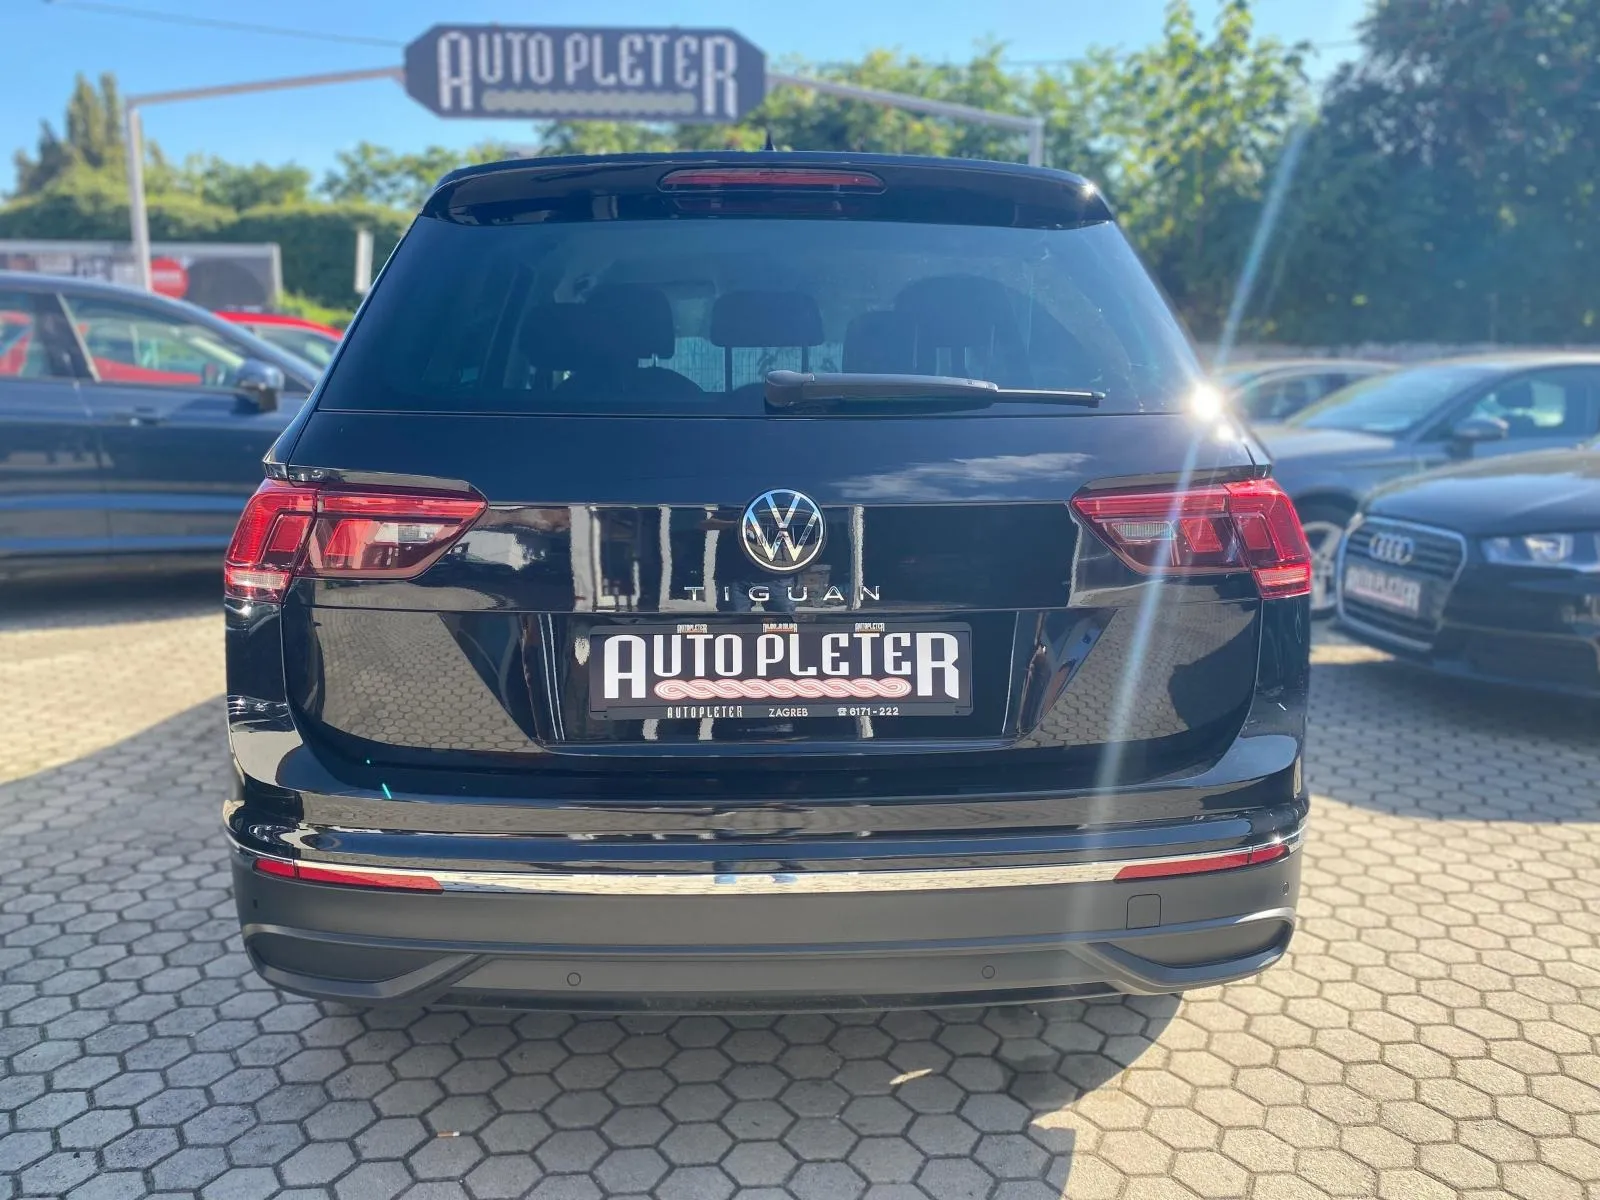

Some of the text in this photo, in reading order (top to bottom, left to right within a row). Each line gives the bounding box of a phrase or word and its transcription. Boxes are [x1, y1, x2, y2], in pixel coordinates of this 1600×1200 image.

[437, 31, 738, 117] AUTO PLETER
[684, 585, 881, 602] TIGUAN
[603, 632, 960, 699] AUTO PLETER
[768, 708, 809, 718] ZAGREB
